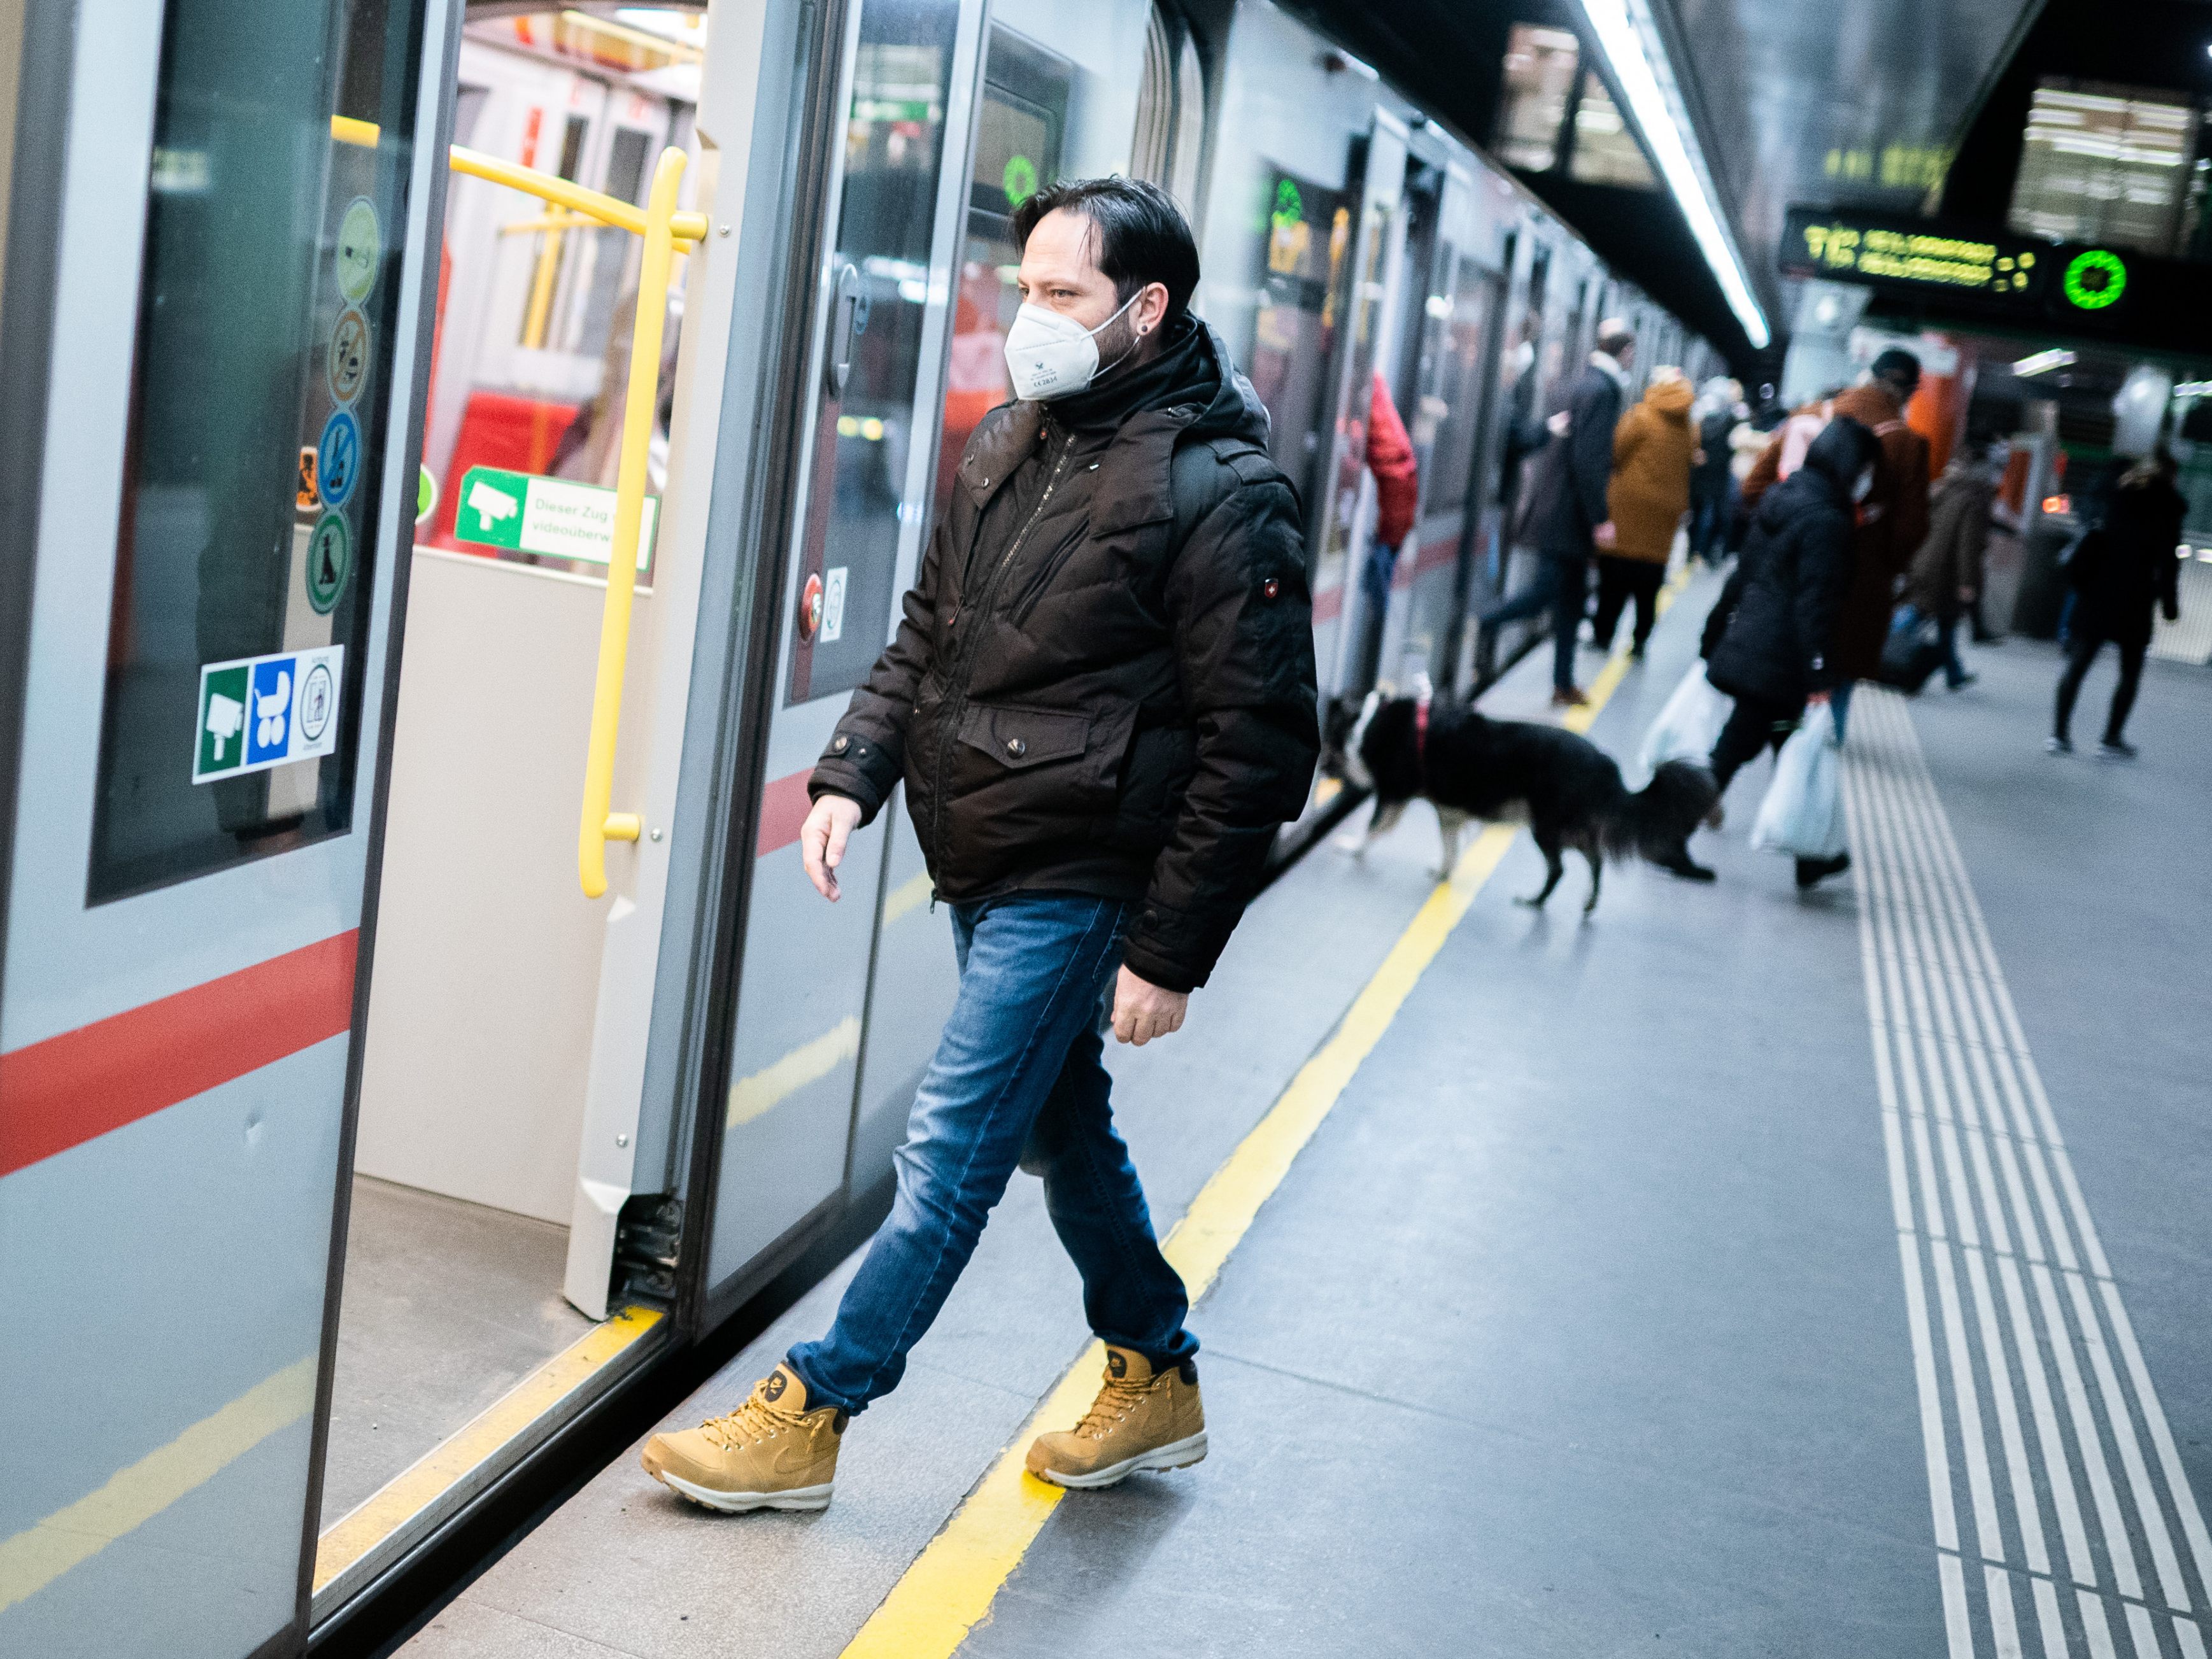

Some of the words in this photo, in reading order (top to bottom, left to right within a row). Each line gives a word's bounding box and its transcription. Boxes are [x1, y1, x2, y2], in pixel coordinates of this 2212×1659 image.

[535, 498, 577, 514] Dieser
[582, 506, 608, 524] Zug
[533, 521, 613, 542] videoüberw
